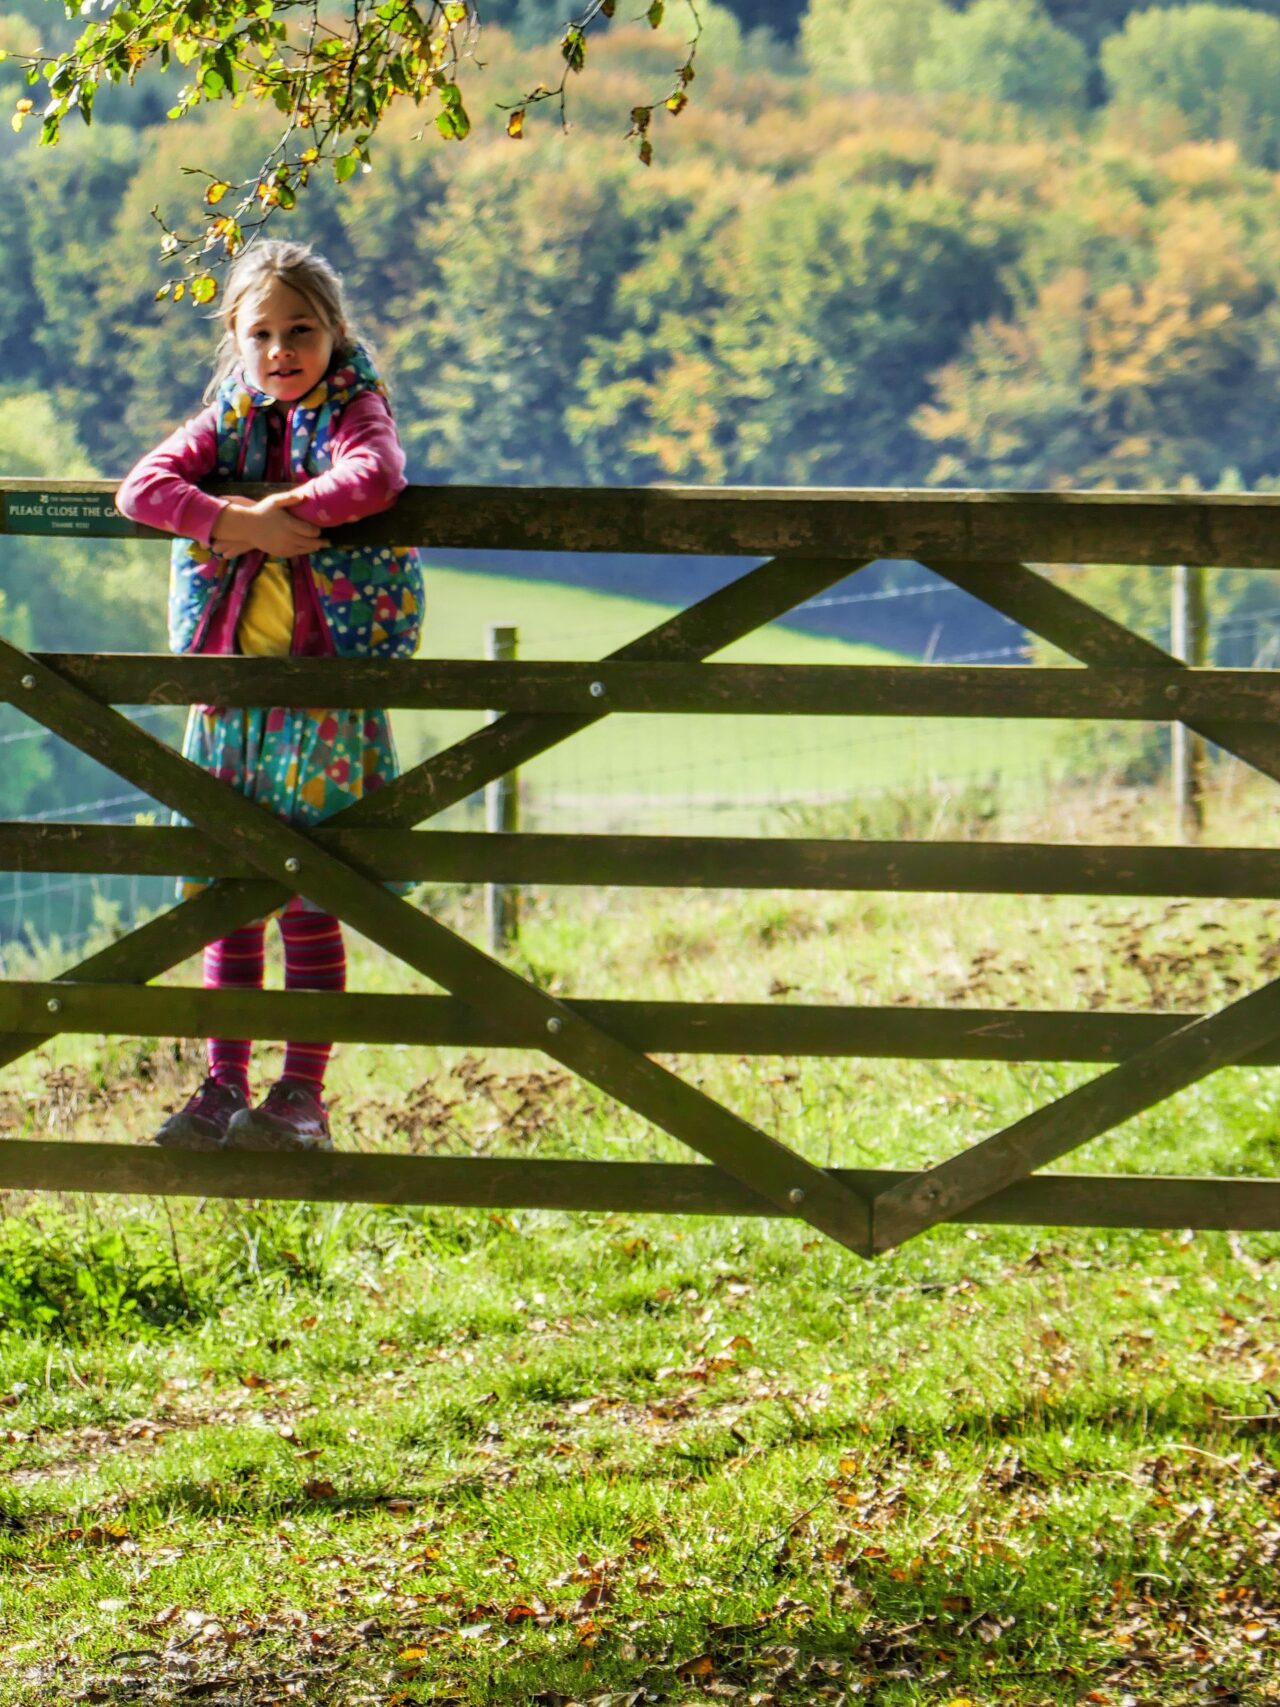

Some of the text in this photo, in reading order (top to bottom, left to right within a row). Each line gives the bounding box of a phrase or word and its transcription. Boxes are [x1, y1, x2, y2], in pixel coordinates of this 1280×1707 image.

[9, 505, 125, 517] PLEASE CLOSE THE GA
